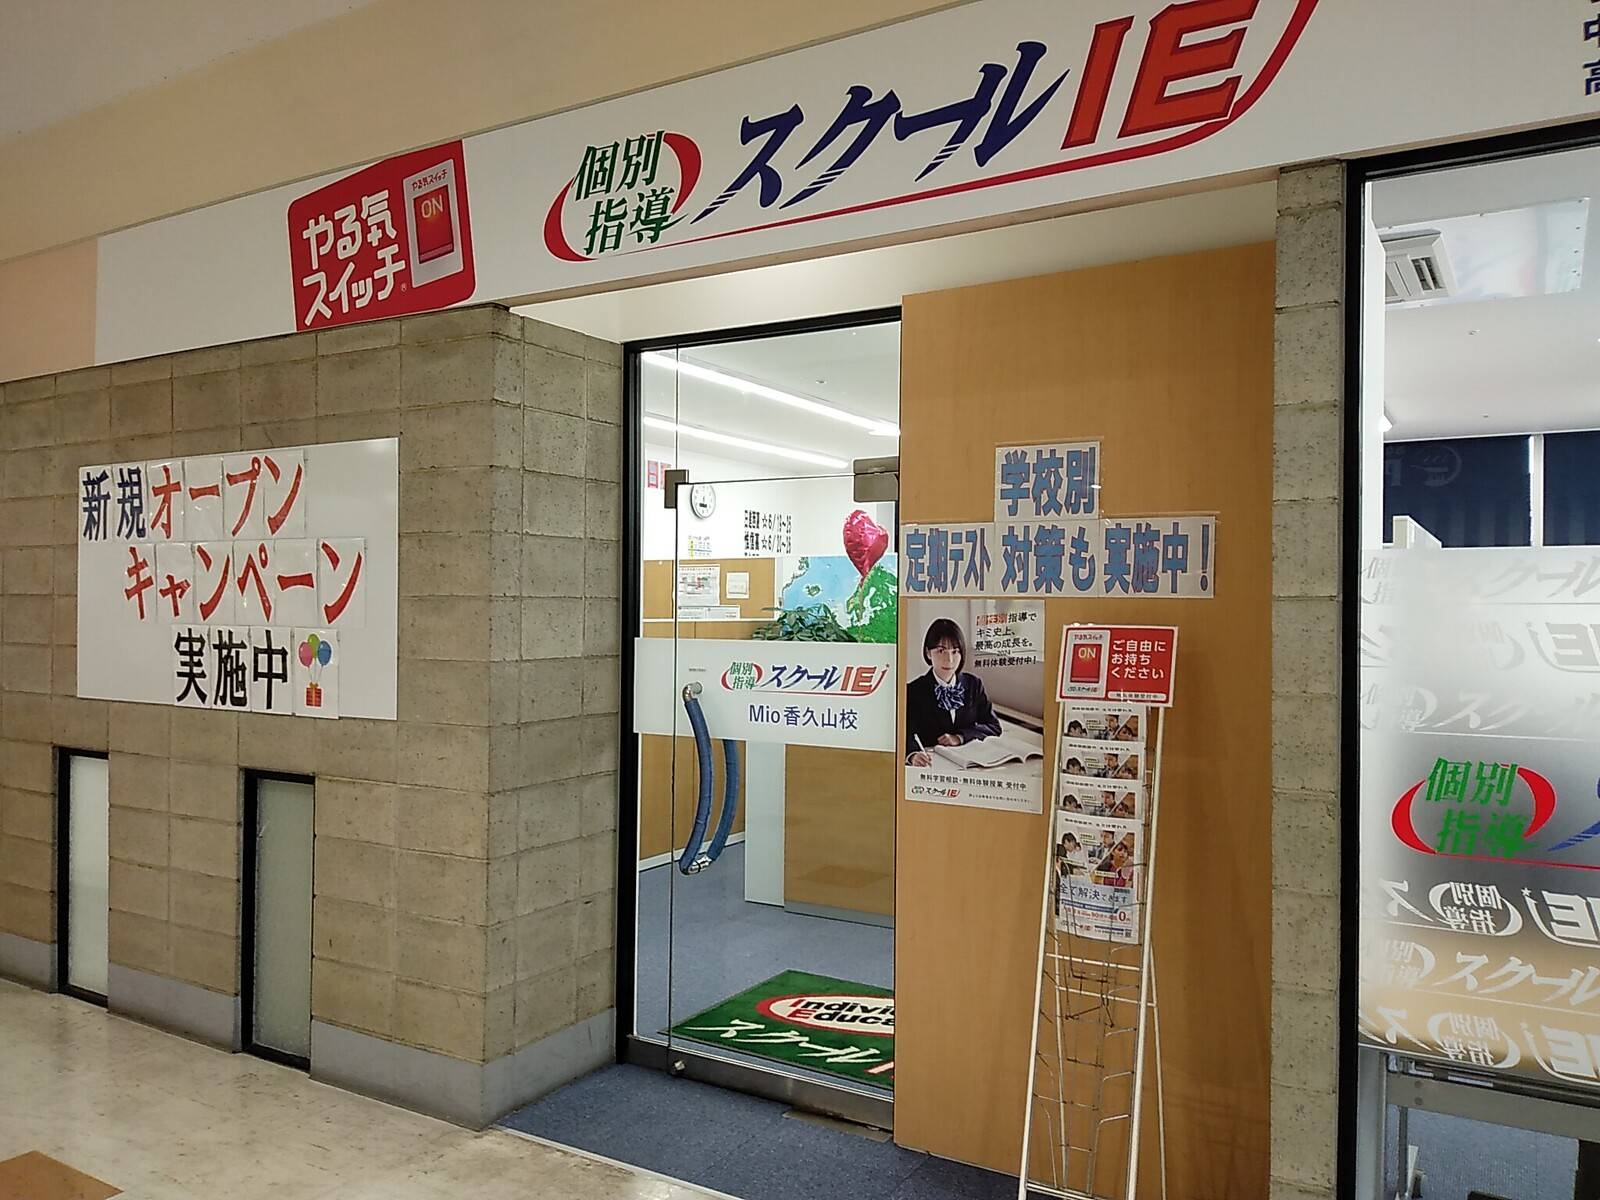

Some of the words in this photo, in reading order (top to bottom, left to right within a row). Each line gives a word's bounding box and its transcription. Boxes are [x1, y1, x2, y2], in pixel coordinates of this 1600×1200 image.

[690, 0, 1257, 224] スクールIE
[571, 130, 665, 201] 個別
[303, 190, 397, 270] やる気
[422, 194, 443, 218] ON
[583, 187, 689, 255] 指導
[303, 244, 406, 326] スイッチ
[83, 455, 303, 541] 新規オープン
[1000, 446, 1096, 517] 学校別
[124, 543, 362, 625] キャンペーン
[174, 628, 288, 710] 実施中
[730, 661, 753, 675] 個別
[1078, 647, 1096, 659] ON
[1111, 654, 1151, 665] お持ち
[1112, 640, 1167, 653] ご自由に
[732, 676, 755, 690] 指導
[760, 664, 877, 692] スクールIE
[1111, 667, 1165, 679] ください
[1425, 757, 1518, 806] 個別
[789, 998, 894, 1015] Indivi
